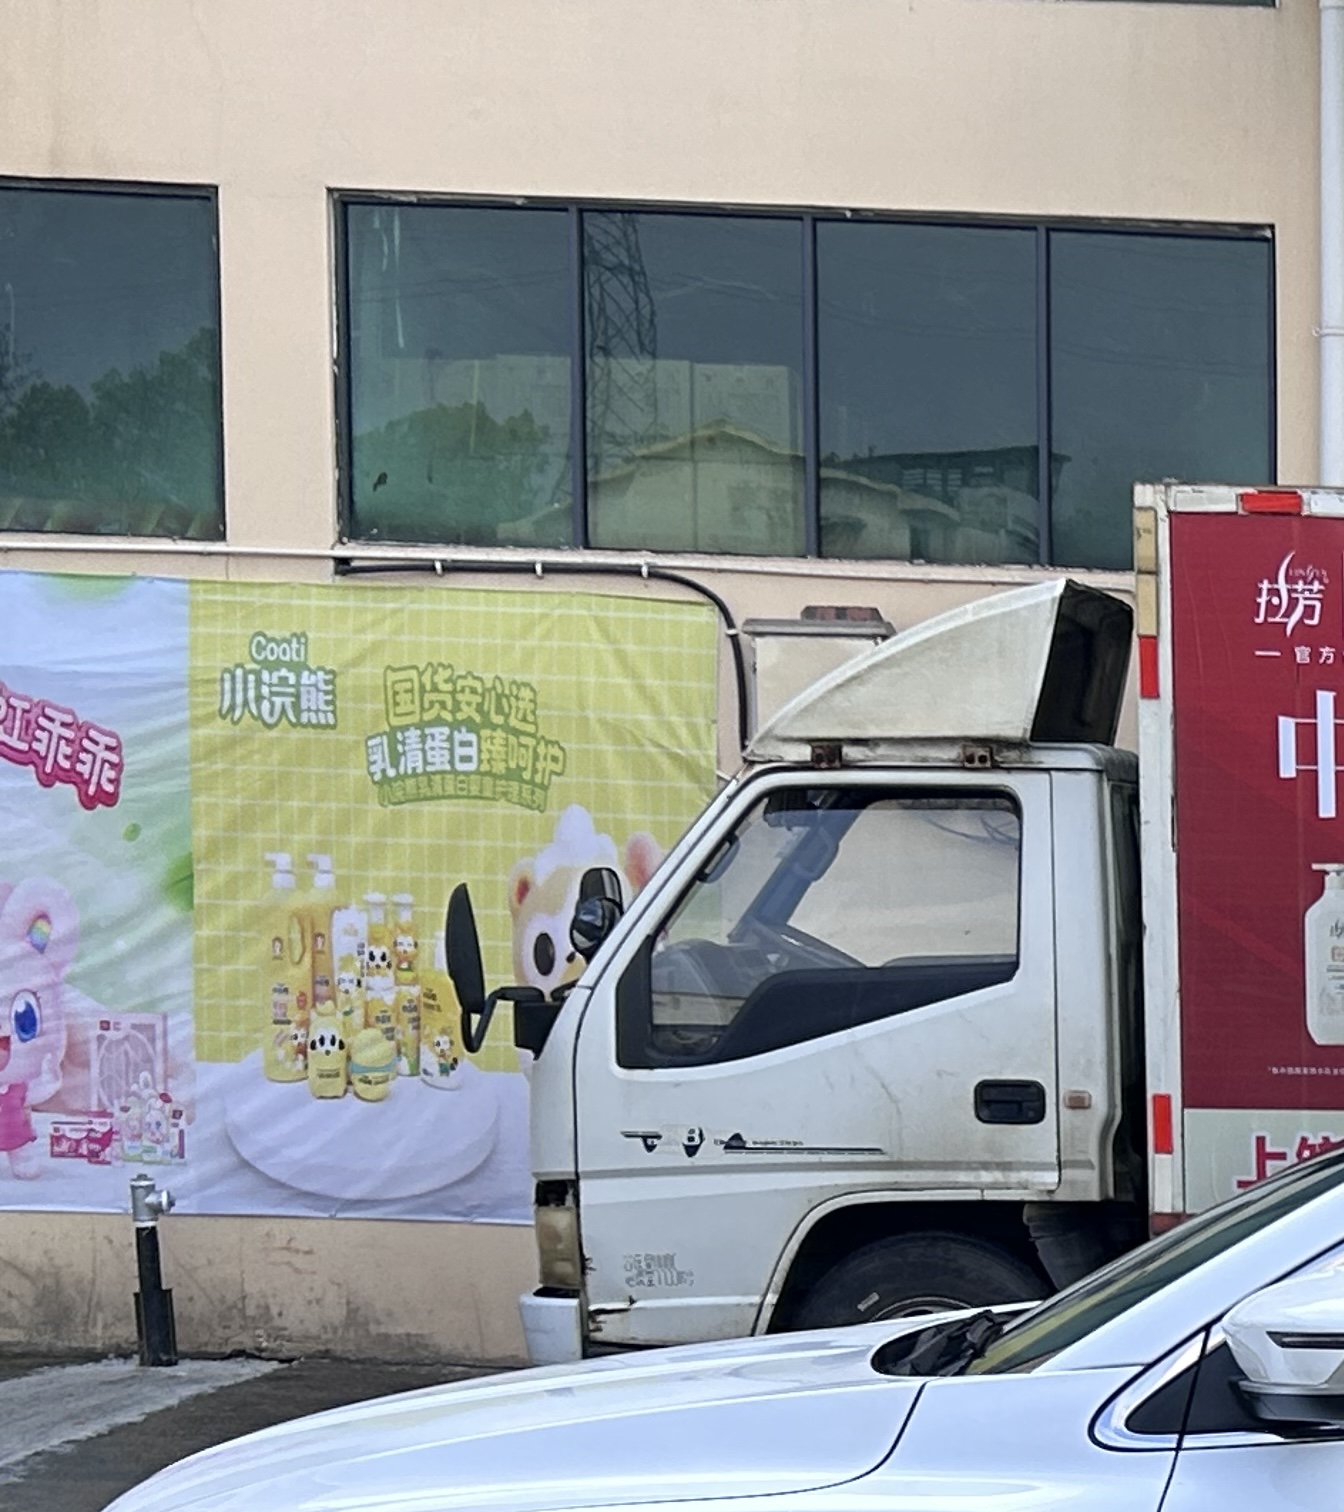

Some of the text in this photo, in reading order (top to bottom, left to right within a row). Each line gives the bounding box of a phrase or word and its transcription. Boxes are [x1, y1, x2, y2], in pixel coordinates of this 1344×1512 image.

[250, 632, 307, 663] Coati
[218, 664, 337, 729] 小浣熊
[384, 663, 539, 734] 国货安心选
